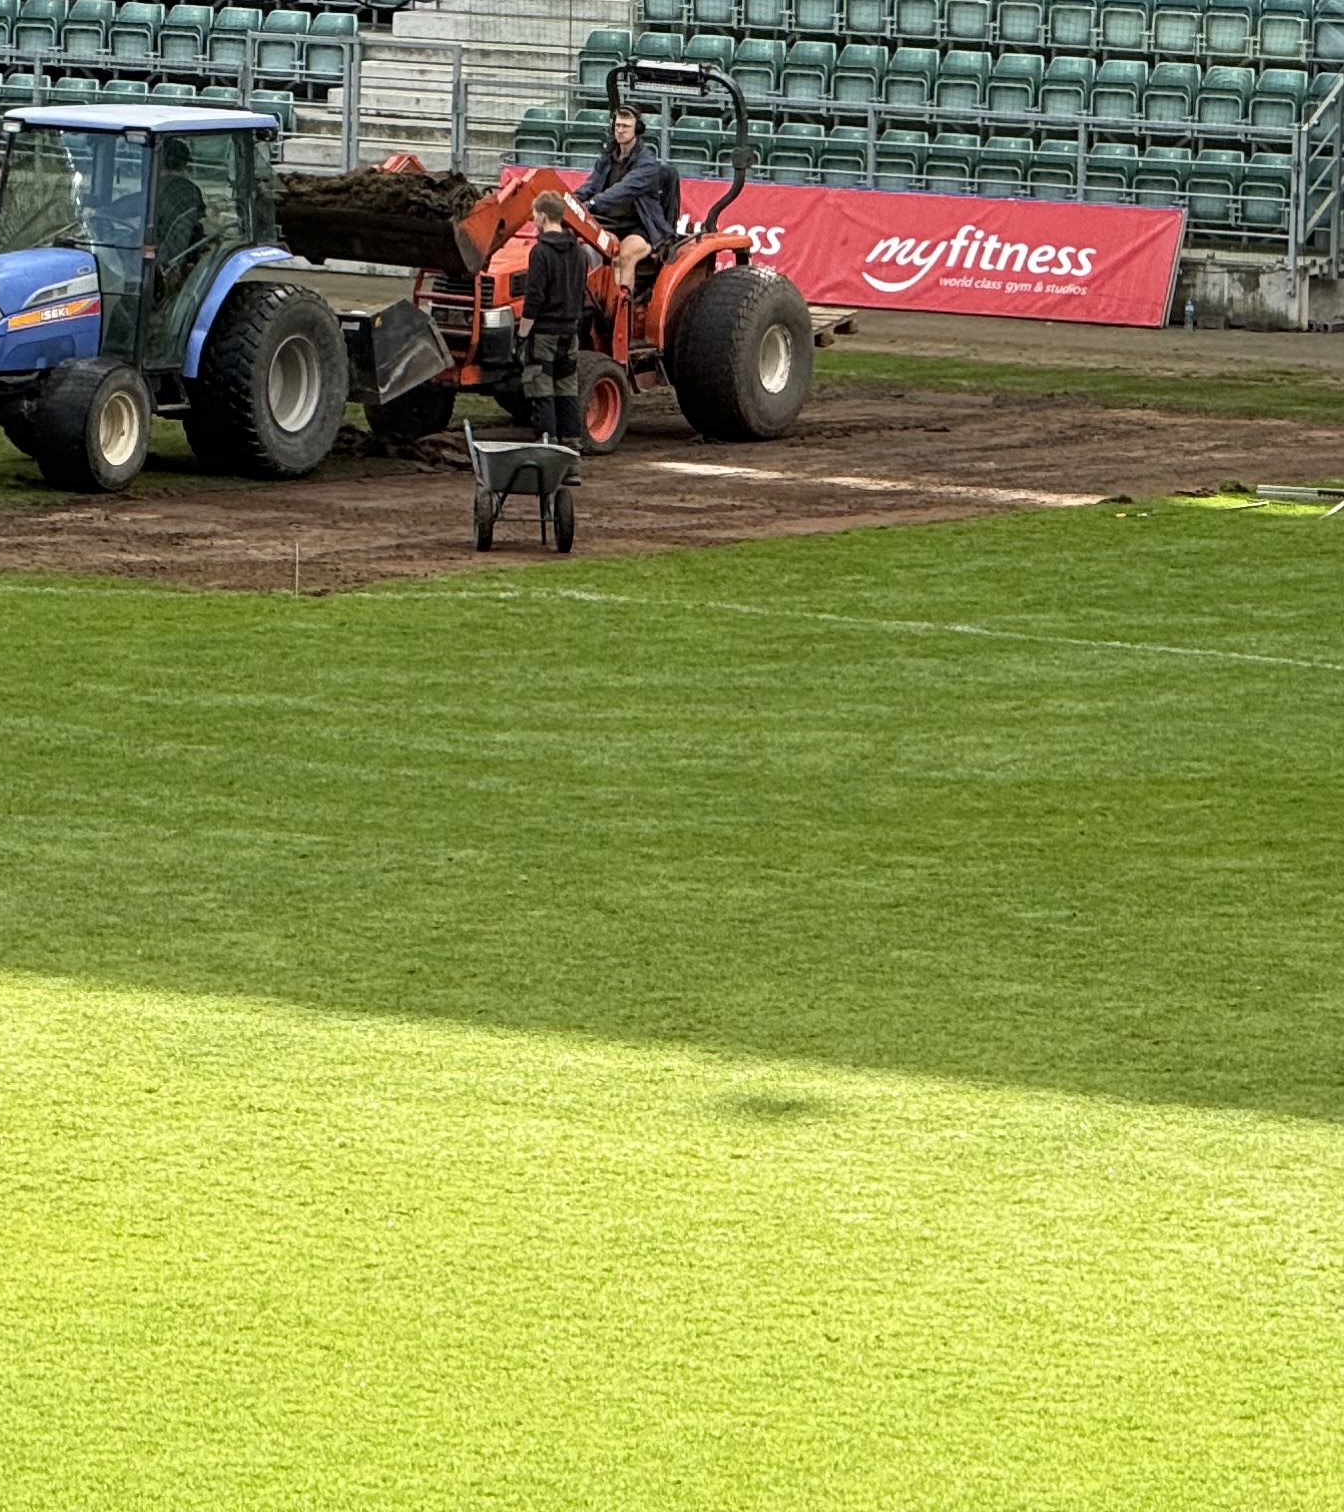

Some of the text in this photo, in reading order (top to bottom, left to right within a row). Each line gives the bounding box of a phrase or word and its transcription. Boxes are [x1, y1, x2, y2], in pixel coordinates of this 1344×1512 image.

[862, 224, 1098, 293] myfitness
[939, 275, 974, 288] world
[974, 277, 1003, 290] class
[1004, 280, 1032, 294] gym
[1044, 282, 1088, 296] studios
[40, 306, 70, 322] ISEKI
